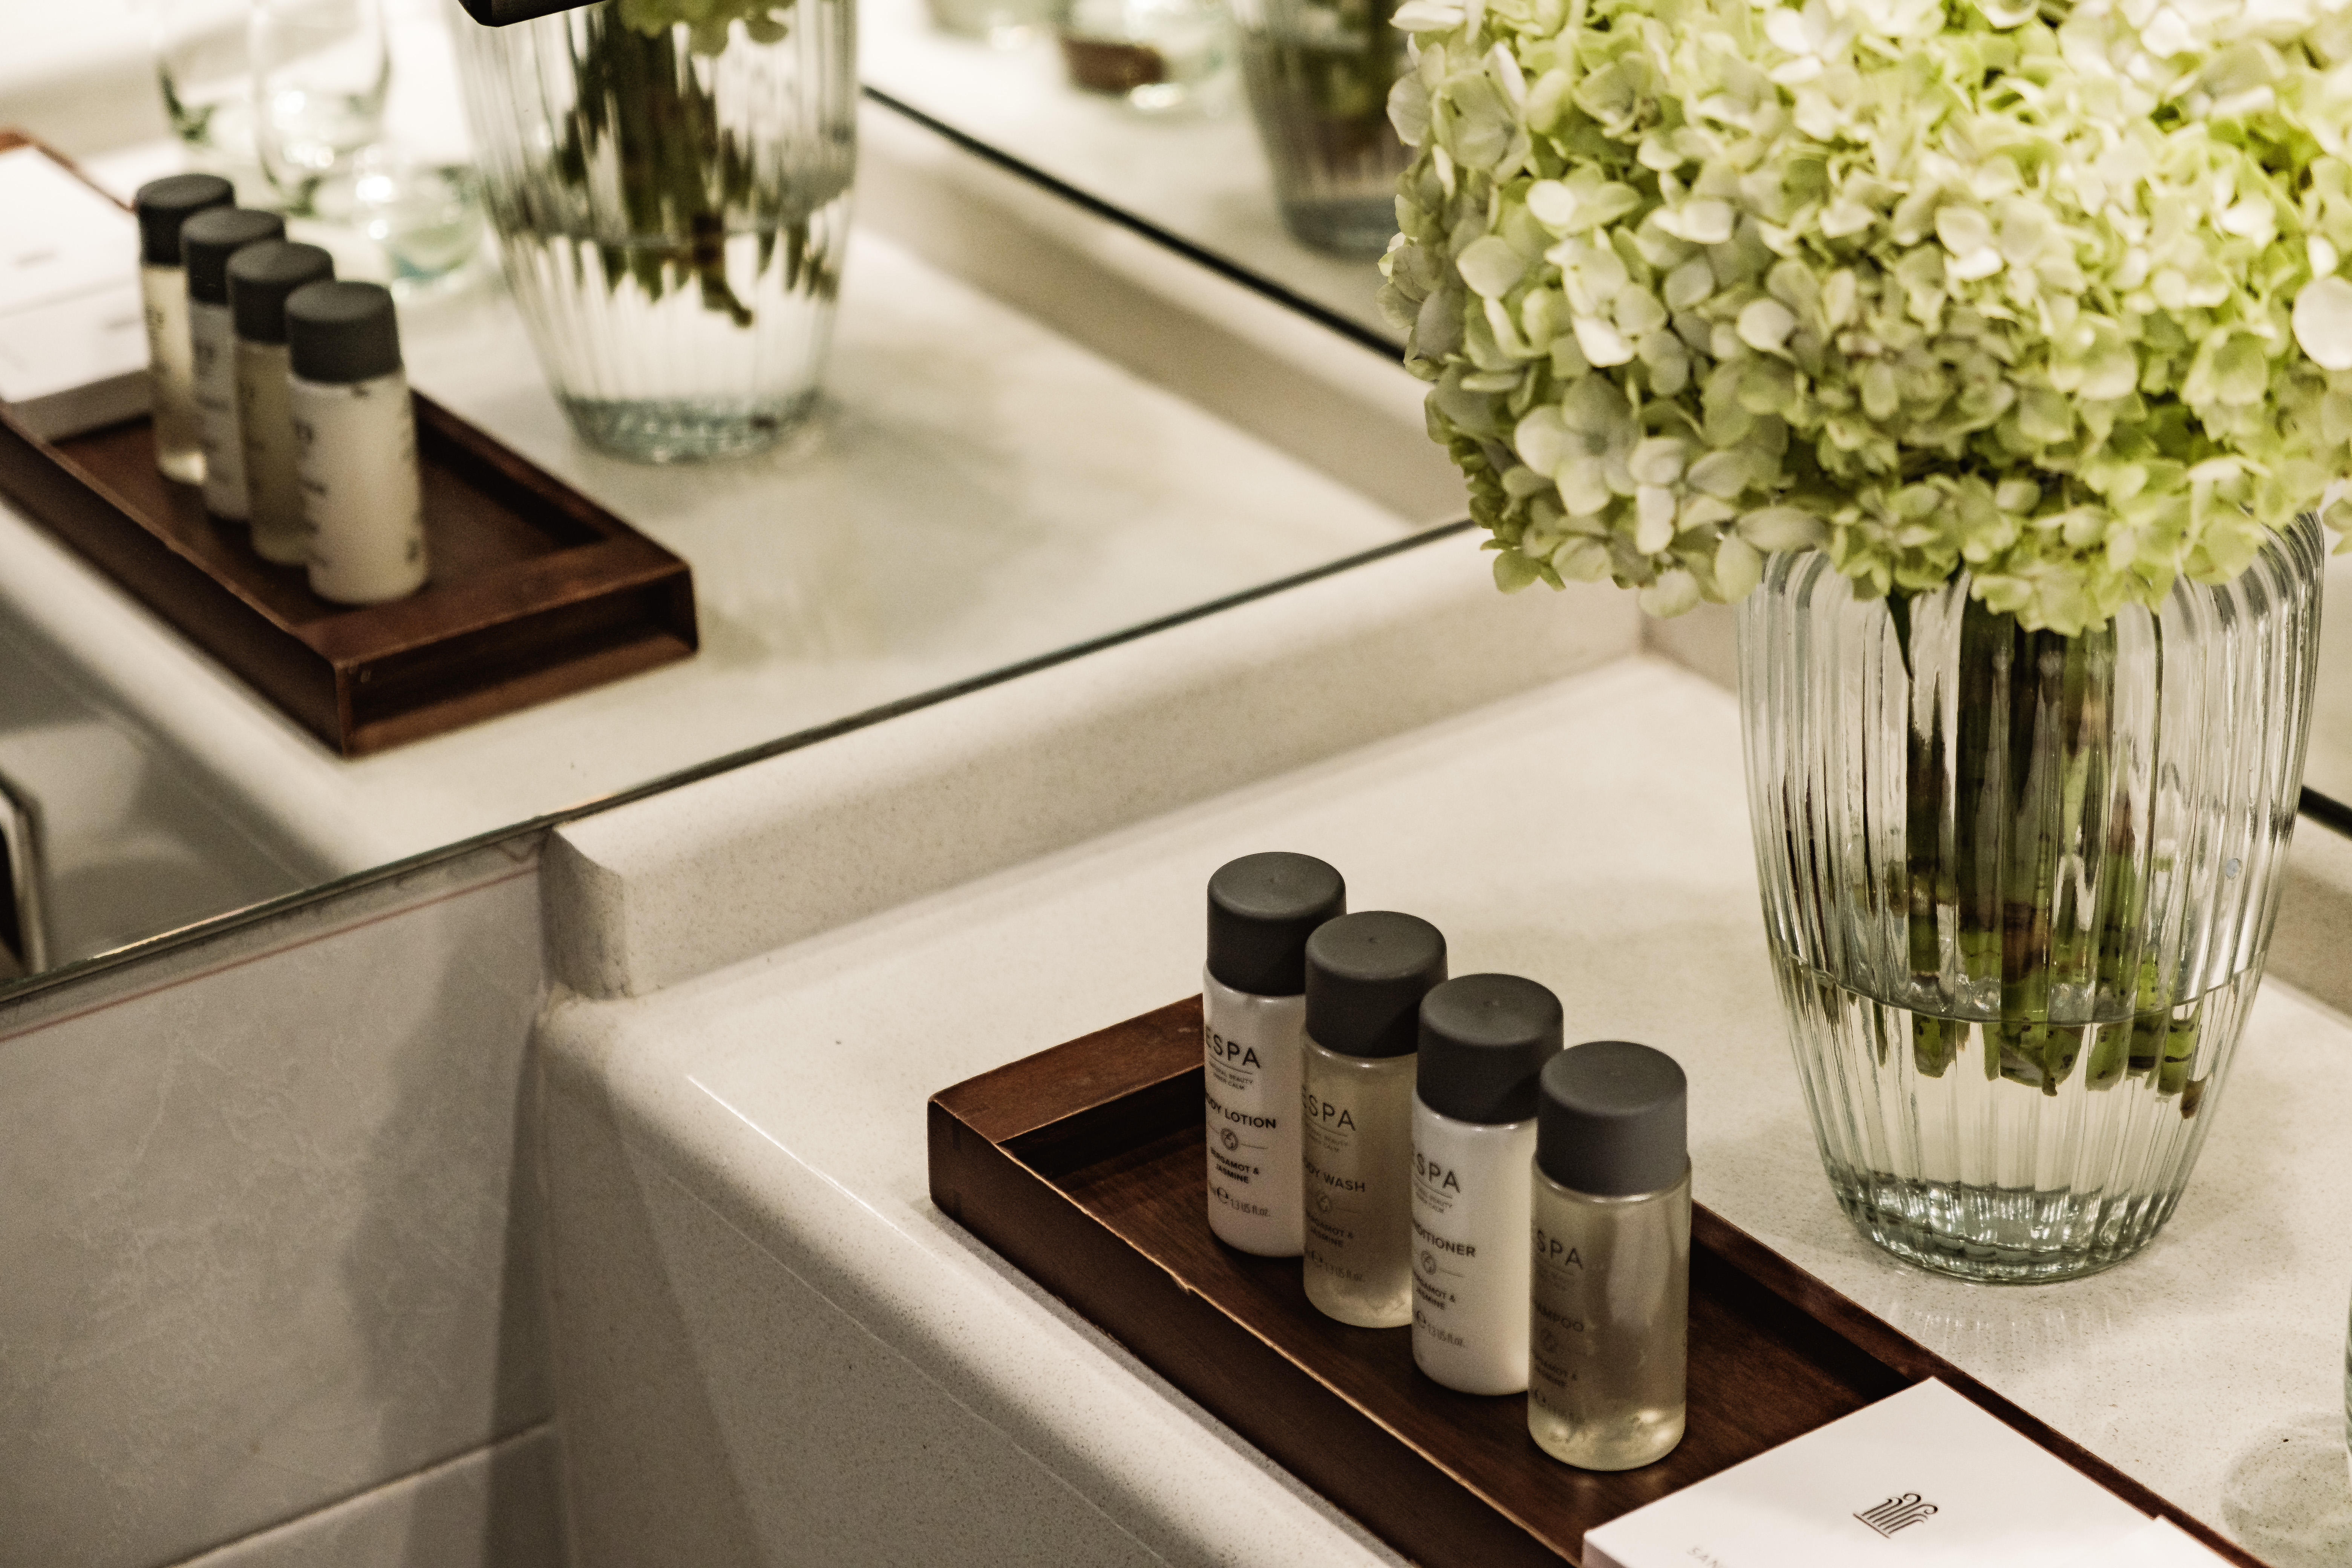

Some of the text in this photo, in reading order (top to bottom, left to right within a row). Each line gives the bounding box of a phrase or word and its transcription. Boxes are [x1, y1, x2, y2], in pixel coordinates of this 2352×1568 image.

[1206, 1093, 1276, 1129] ODY LOTION
[1253, 1167, 1260, 1175] &
[1323, 1171, 1366, 1193] WASH
[1536, 1229, 1584, 1271] SPA
